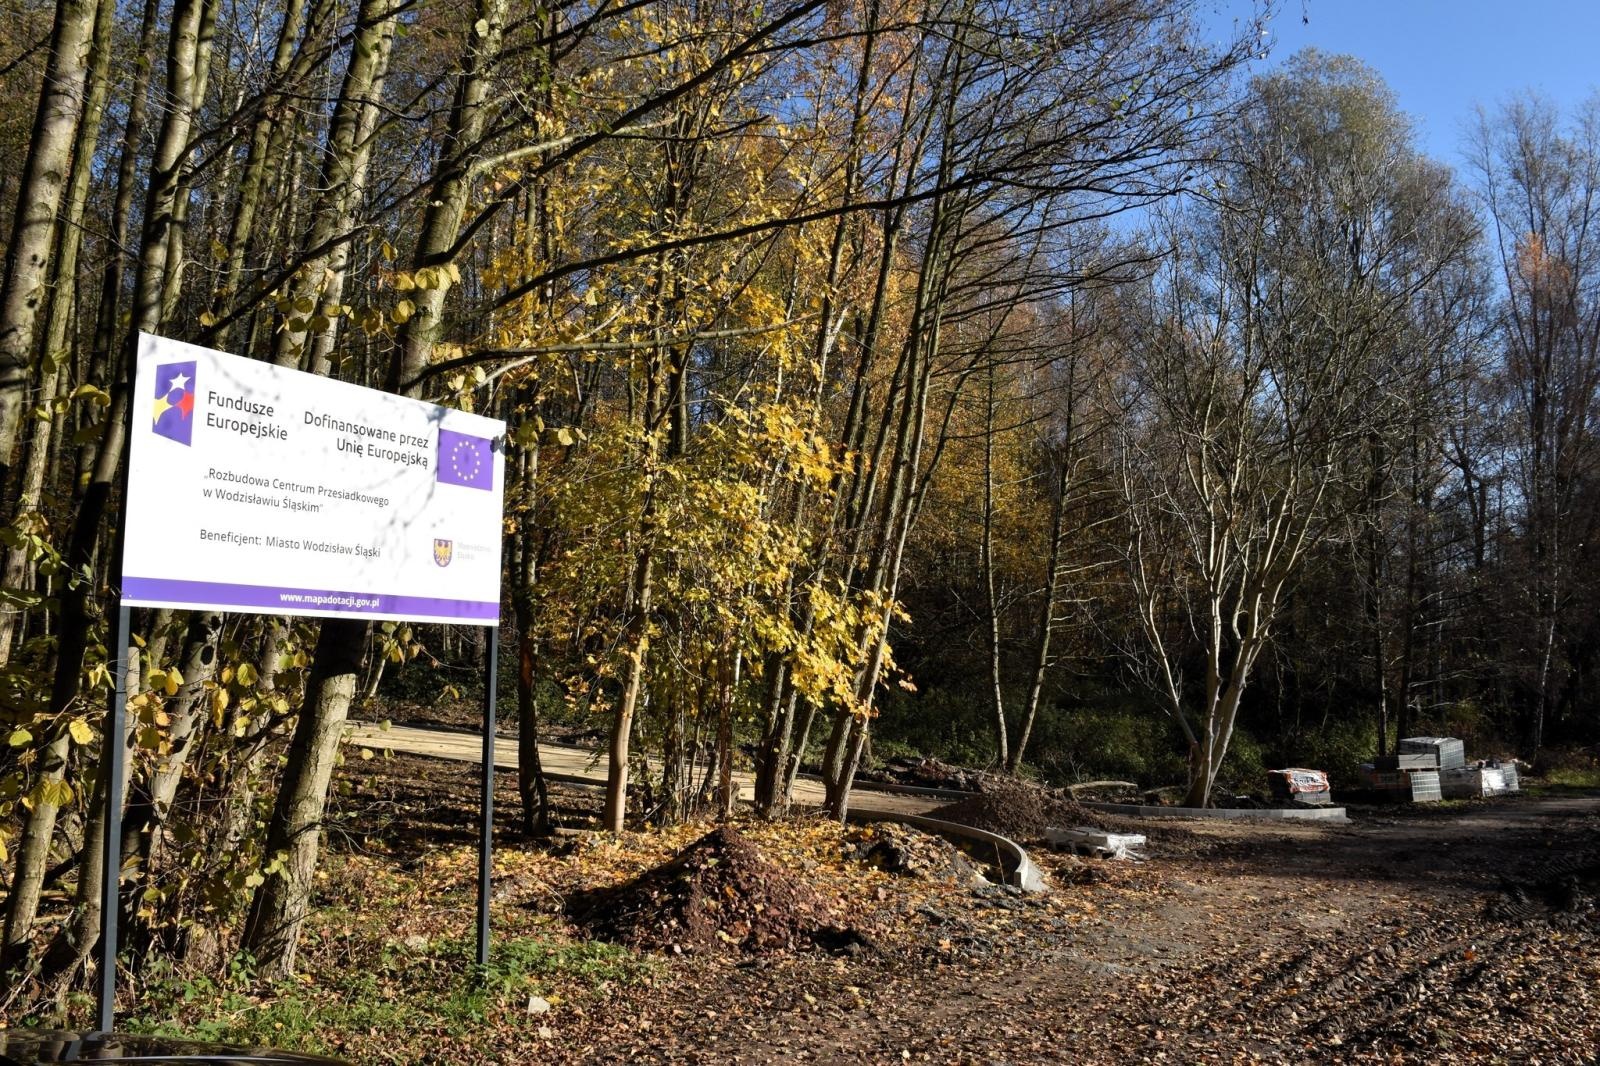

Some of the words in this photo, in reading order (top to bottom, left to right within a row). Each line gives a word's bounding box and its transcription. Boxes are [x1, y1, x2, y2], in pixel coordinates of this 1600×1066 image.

[208, 391, 274, 417] Fundusze
[206, 412, 288, 440] Europejskie
[304, 411, 396, 442] Dofinansowane
[399, 433, 429, 449] przez
[336, 438, 364, 457] Unię
[367, 444, 428, 470] Europejską
[203, 488, 213, 498] w
[215, 488, 280, 508] Wodzisławiu
[273, 478, 315, 495] Centrum
[318, 485, 390, 508] Przesiadkowego
[200, 529, 262, 546] Beneficjent:
[266, 536, 300, 550] Miasto
[303, 539, 353, 555] Wodzisław
[355, 543, 381, 559] Śląski
[280, 593, 380, 608] www.mapadotacji.gov.pl
